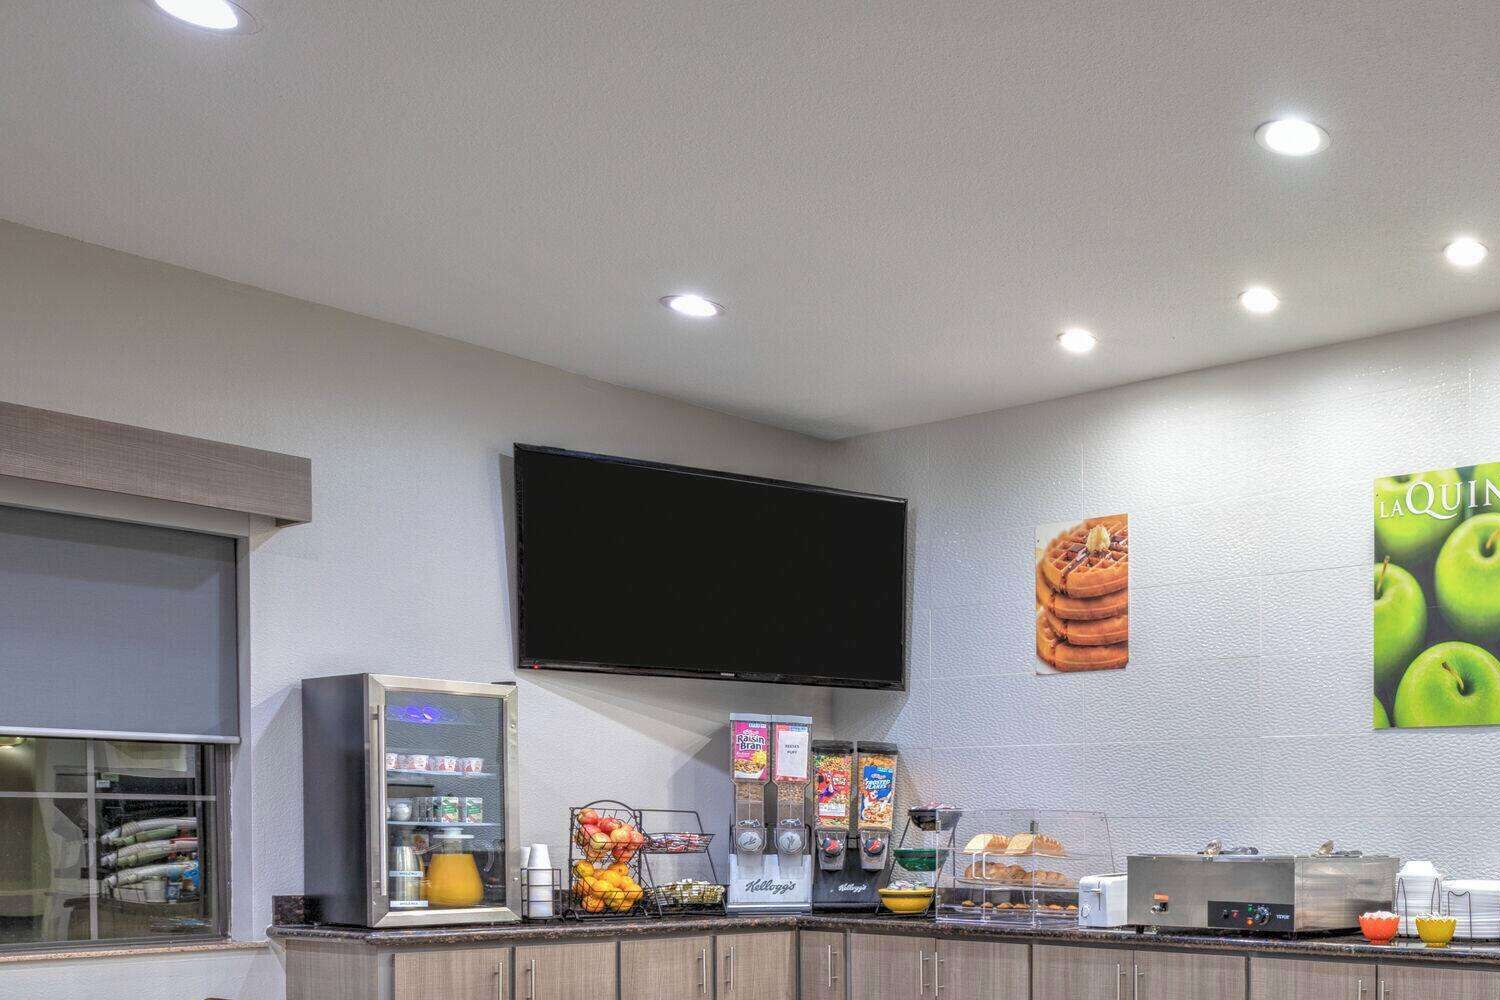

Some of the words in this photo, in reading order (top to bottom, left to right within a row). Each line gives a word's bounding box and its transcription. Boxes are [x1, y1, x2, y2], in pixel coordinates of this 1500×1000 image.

[1379, 499, 1405, 519] LA
[736, 734, 766, 745] Raisin
[739, 742, 763, 751] Bran
[745, 879, 796, 895] Kellogg's
[838, 882, 868, 893] Kellogg's
